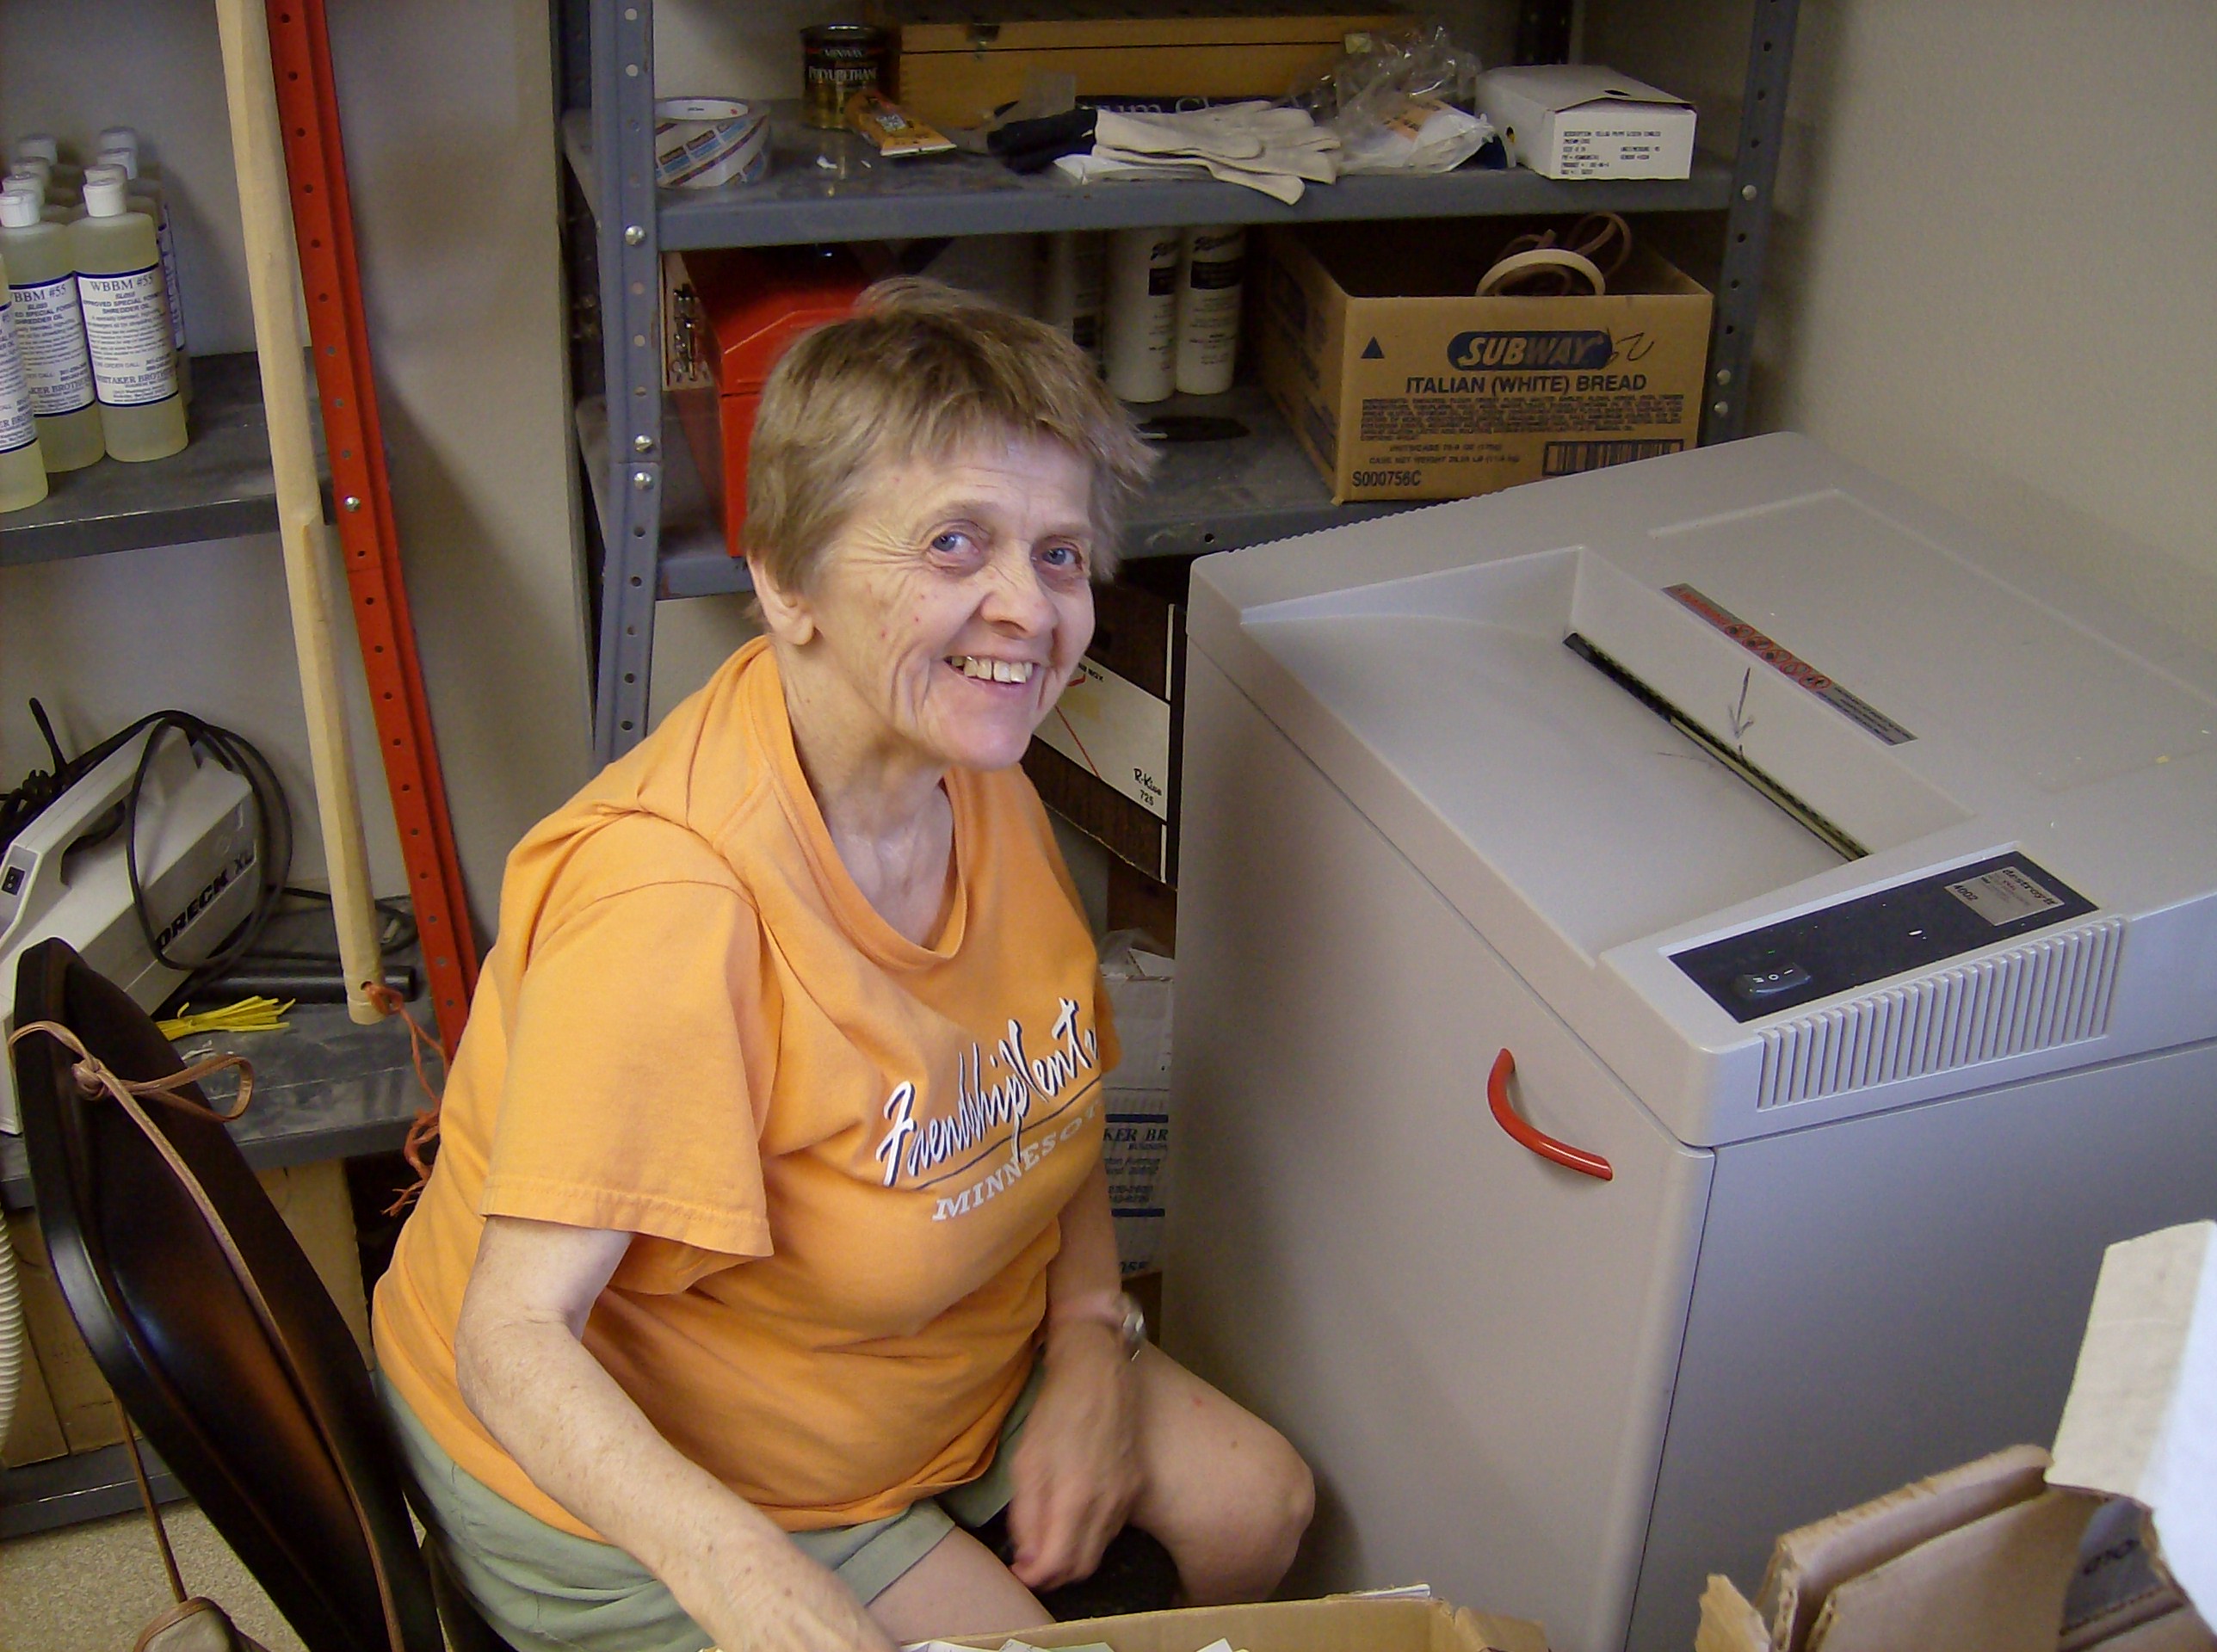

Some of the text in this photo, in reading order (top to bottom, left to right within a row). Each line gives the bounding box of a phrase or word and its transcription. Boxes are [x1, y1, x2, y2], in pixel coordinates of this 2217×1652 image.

[49, 284, 67, 299] #55
[90, 279, 133, 293] WBBM
[1457, 336, 1603, 367] SUBWAY
[1405, 374, 1647, 396] ITALIAN (WHITE) BREAD
[1352, 470, 1422, 488] S000756C
[1953, 885, 1979, 901] 4002
[157, 869, 229, 948] ORECK
